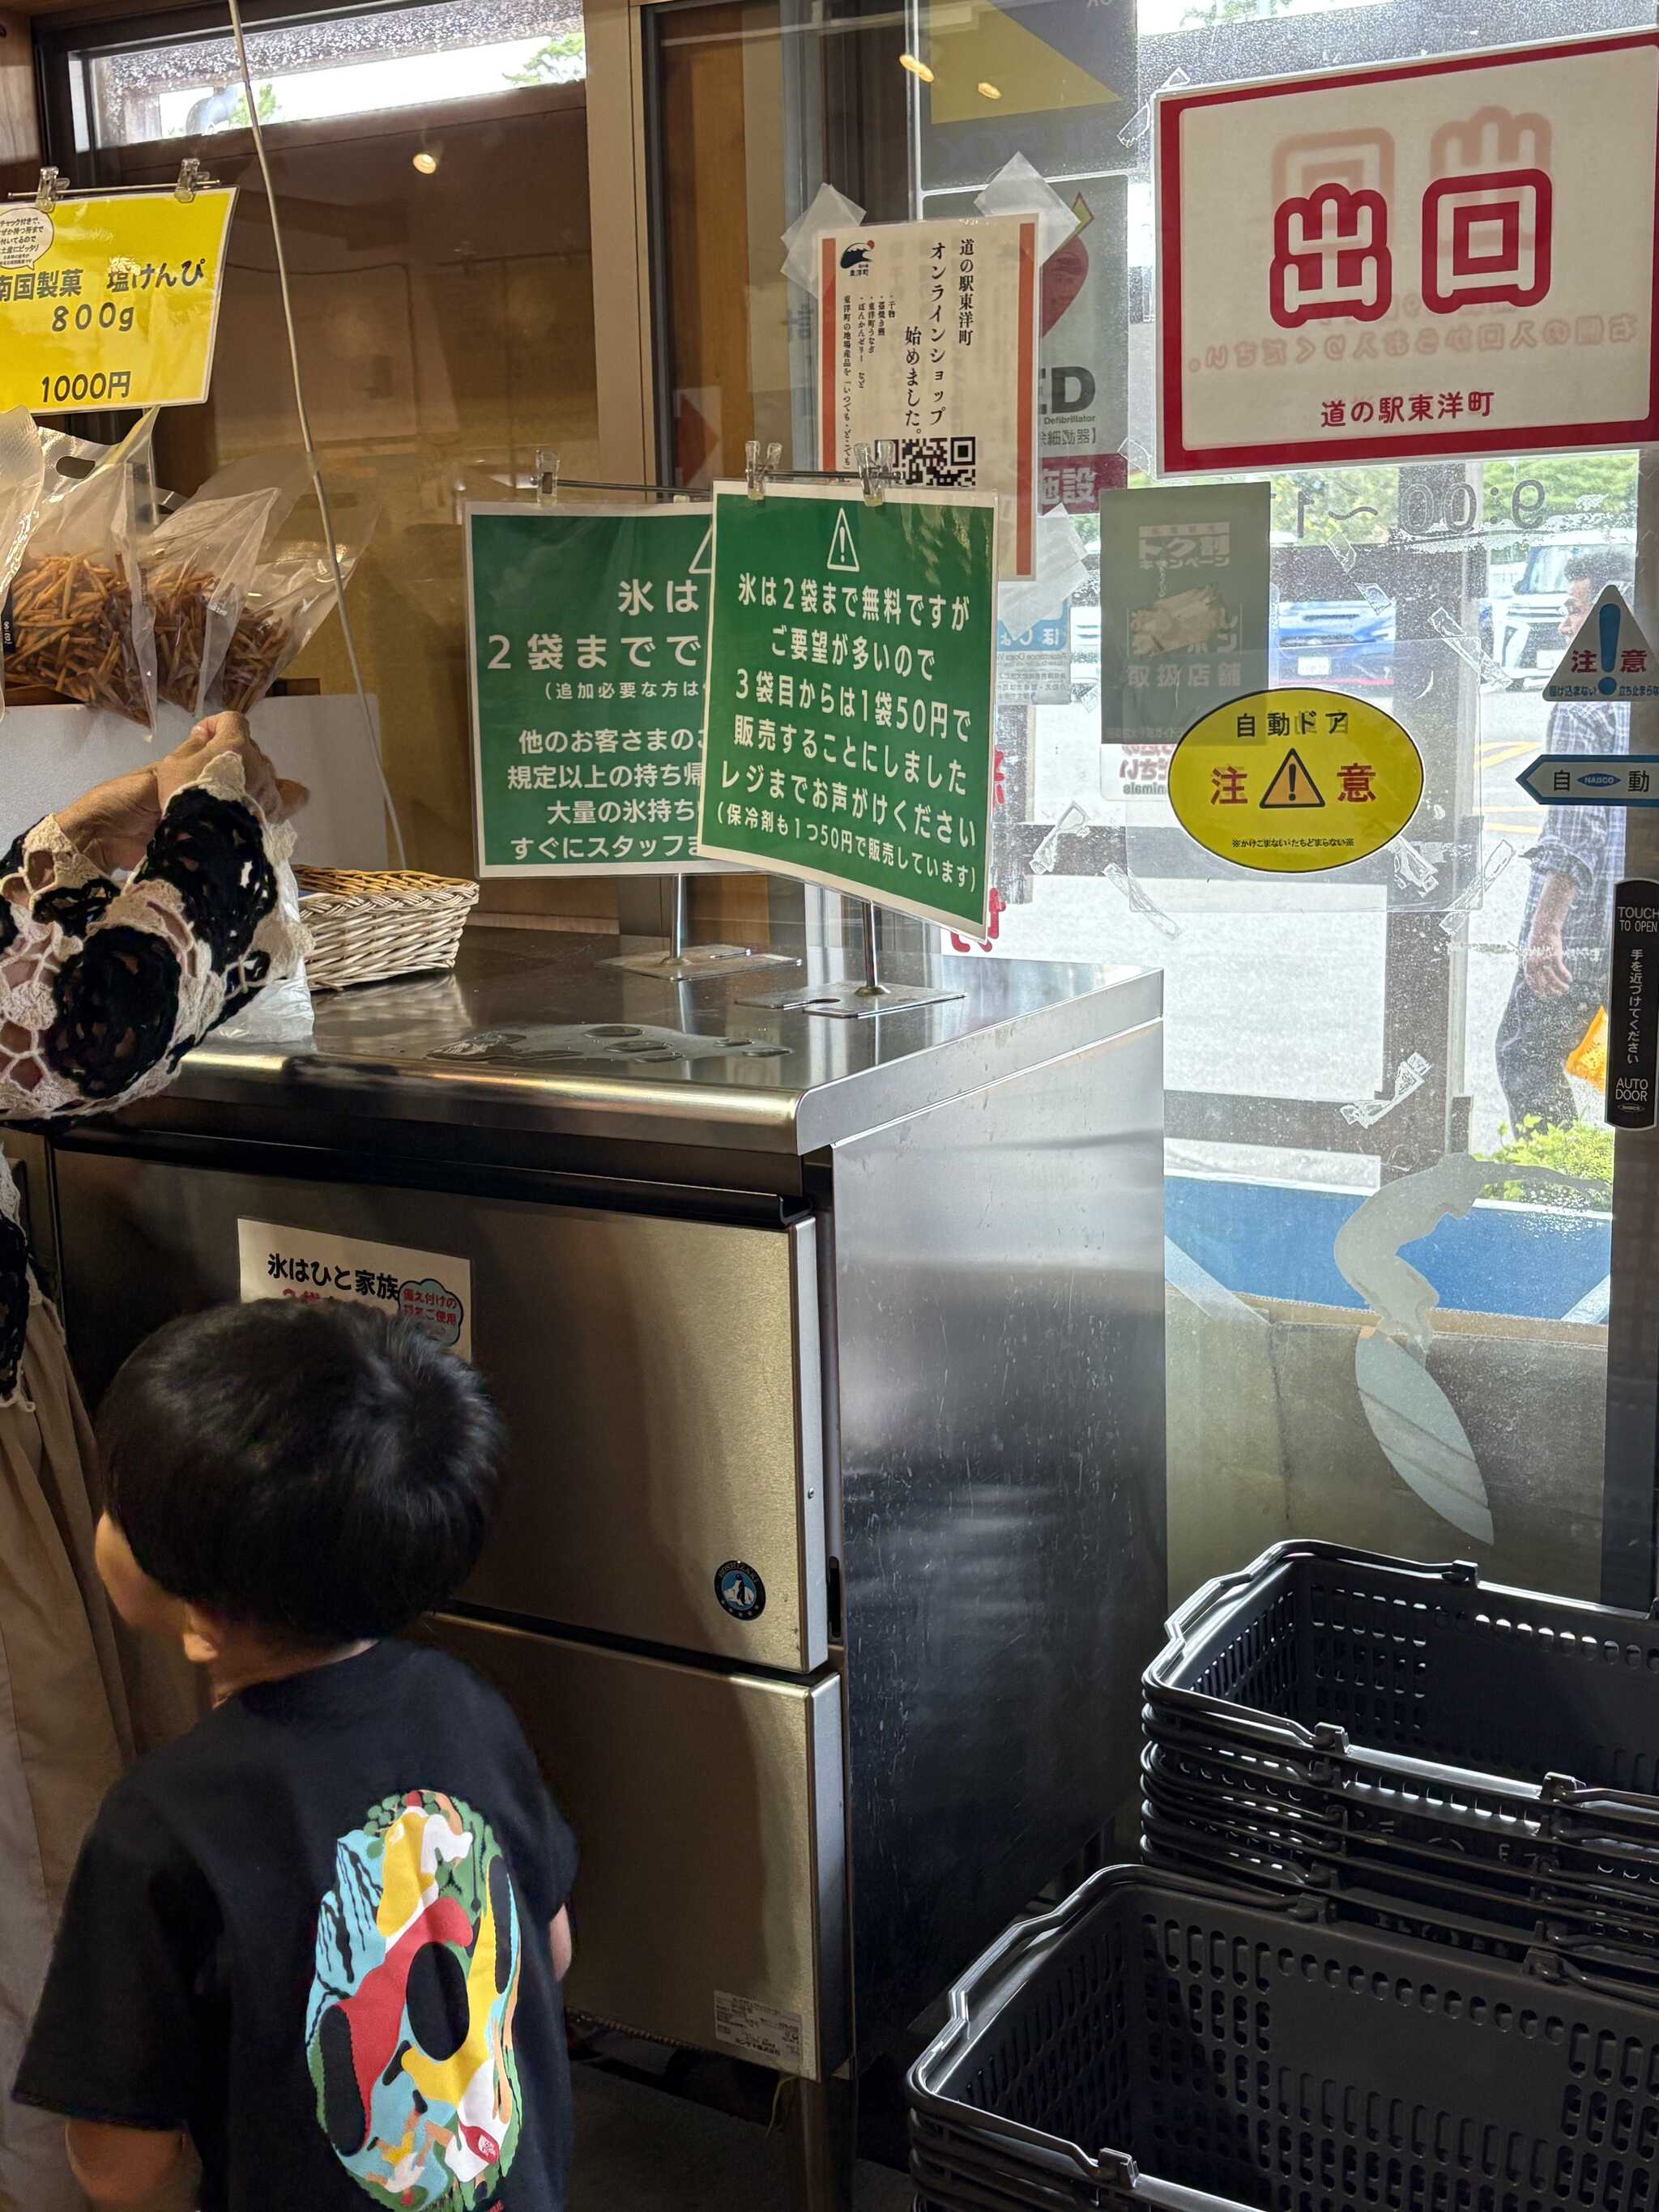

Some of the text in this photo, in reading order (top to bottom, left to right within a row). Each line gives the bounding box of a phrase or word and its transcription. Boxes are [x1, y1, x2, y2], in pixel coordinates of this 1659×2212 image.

[1269, 168, 1553, 328] 出口
[52, 302, 134, 331] 800g
[959, 238, 975, 347] 道の駅東洋町
[930, 242, 946, 426] オンラインショップ
[41, 371, 131, 403] 1000円
[905, 326, 922, 434] 始めました。
[1042, 366, 1096, 415] D
[1320, 391, 1495, 428] 道の駅東洋町
[618, 579, 699, 616] 氷は
[737, 572, 970, 633] 氷は2袋まで無料ですが
[487, 633, 702, 671] 2袋までで
[771, 624, 936, 681] ご要望が多いので
[544, 680, 706, 701] (追加必要な方は
[735, 669, 972, 743] 3袋目からは1袋50円で
[1236, 712, 1349, 738] 自動ドア
[733, 714, 966, 795] 販売することにしました
[547, 799, 700, 825] 大量の氷持ち
[721, 761, 976, 848] レジまでお声がけください
[717, 801, 976, 892] (保冷剤も1つ50円で販売しています)
[1618, 906, 1659, 919] TOUCH
[1619, 919, 1657, 932] TO OPEN
[1627, 948, 1644, 1064] 手を近づけてください
[1615, 1089, 1648, 1102] DOOR
[1616, 1077, 1648, 1090] AUTO
[267, 1253, 399, 1301] 氷はひと家族
